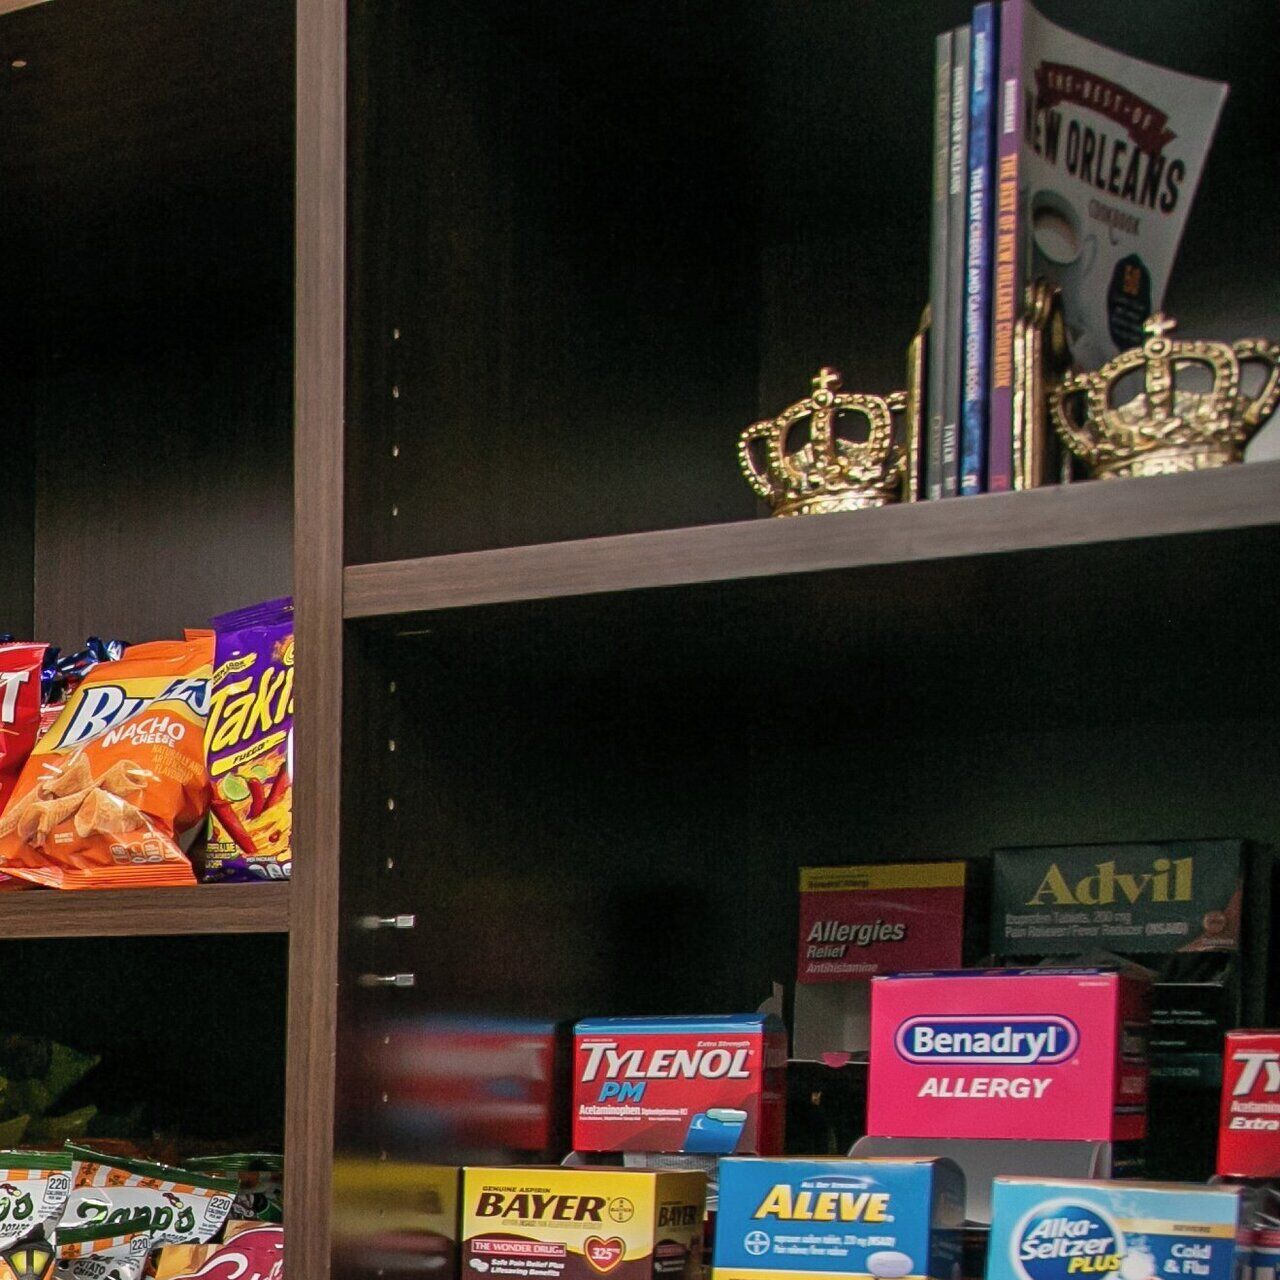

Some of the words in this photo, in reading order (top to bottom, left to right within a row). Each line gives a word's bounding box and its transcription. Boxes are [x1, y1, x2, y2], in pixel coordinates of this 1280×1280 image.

[1066, 119, 1186, 215] ORLEANS
[101, 716, 186, 748] NACHO
[131, 732, 176, 748] CHEESE
[1024, 856, 1194, 907] Advil
[806, 919, 907, 946] Allergies
[805, 943, 846, 959] Relief
[912, 1026, 1059, 1058] Benadryl
[579, 1042, 751, 1083] TYLENOL
[598, 1081, 648, 1103] PM
[917, 1077, 1053, 1099] ALLERGY
[579, 1104, 642, 1117] Acetaminophen
[48, 1178, 69, 1191] 220
[481, 1185, 518, 1193] GENUINE
[518, 1186, 552, 1194] ASPIRIN
[210, 1196, 231, 1210] 220
[475, 1192, 608, 1223] BAYER
[752, 1184, 892, 1223] ALEVE
[658, 1203, 698, 1228] BAYER
[1029, 1217, 1098, 1240] Alka-
[131, 1237, 149, 1250] 220
[474, 1241, 491, 1251] THE
[494, 1243, 533, 1253] WONDER
[1019, 1236, 1115, 1261] Seltzer
[1170, 1242, 1212, 1261] Cold
[490, 1258, 508, 1267] Safe
[508, 1259, 525, 1268] Pain
[525, 1260, 548, 1268] Relief
[592, 1247, 612, 1260] 325
[490, 1267, 528, 1277] Lifesaving
[528, 1268, 561, 1277] Benefits
[1067, 1255, 1126, 1274] PLUS
[1162, 1260, 1178, 1274] &
[1182, 1260, 1210, 1276] Flu
